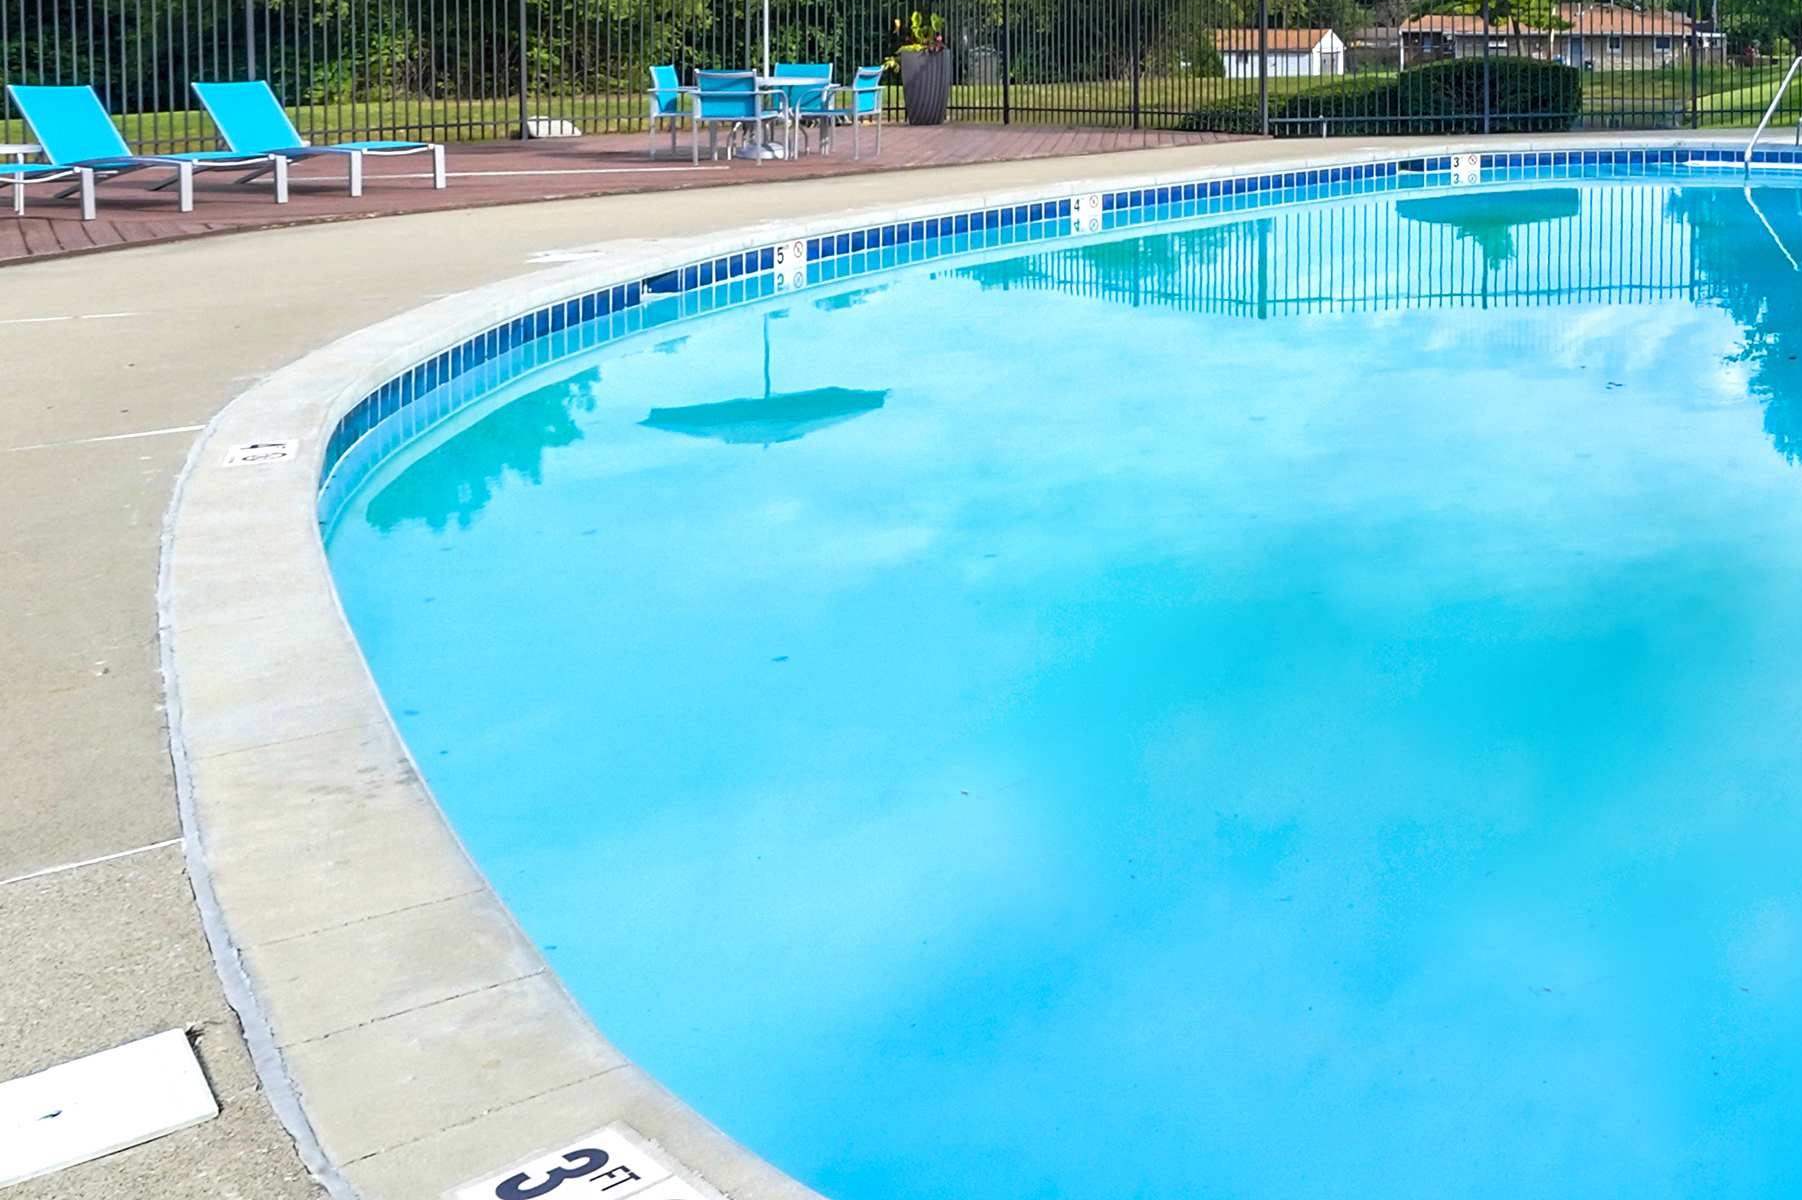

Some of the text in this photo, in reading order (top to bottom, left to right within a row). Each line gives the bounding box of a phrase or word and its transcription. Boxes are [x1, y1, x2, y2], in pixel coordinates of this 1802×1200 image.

[1453, 156, 1460, 168] 3
[1073, 198, 1080, 212] 4
[776, 246, 785, 264] 5
[495, 1148, 641, 1200] 3 FT
